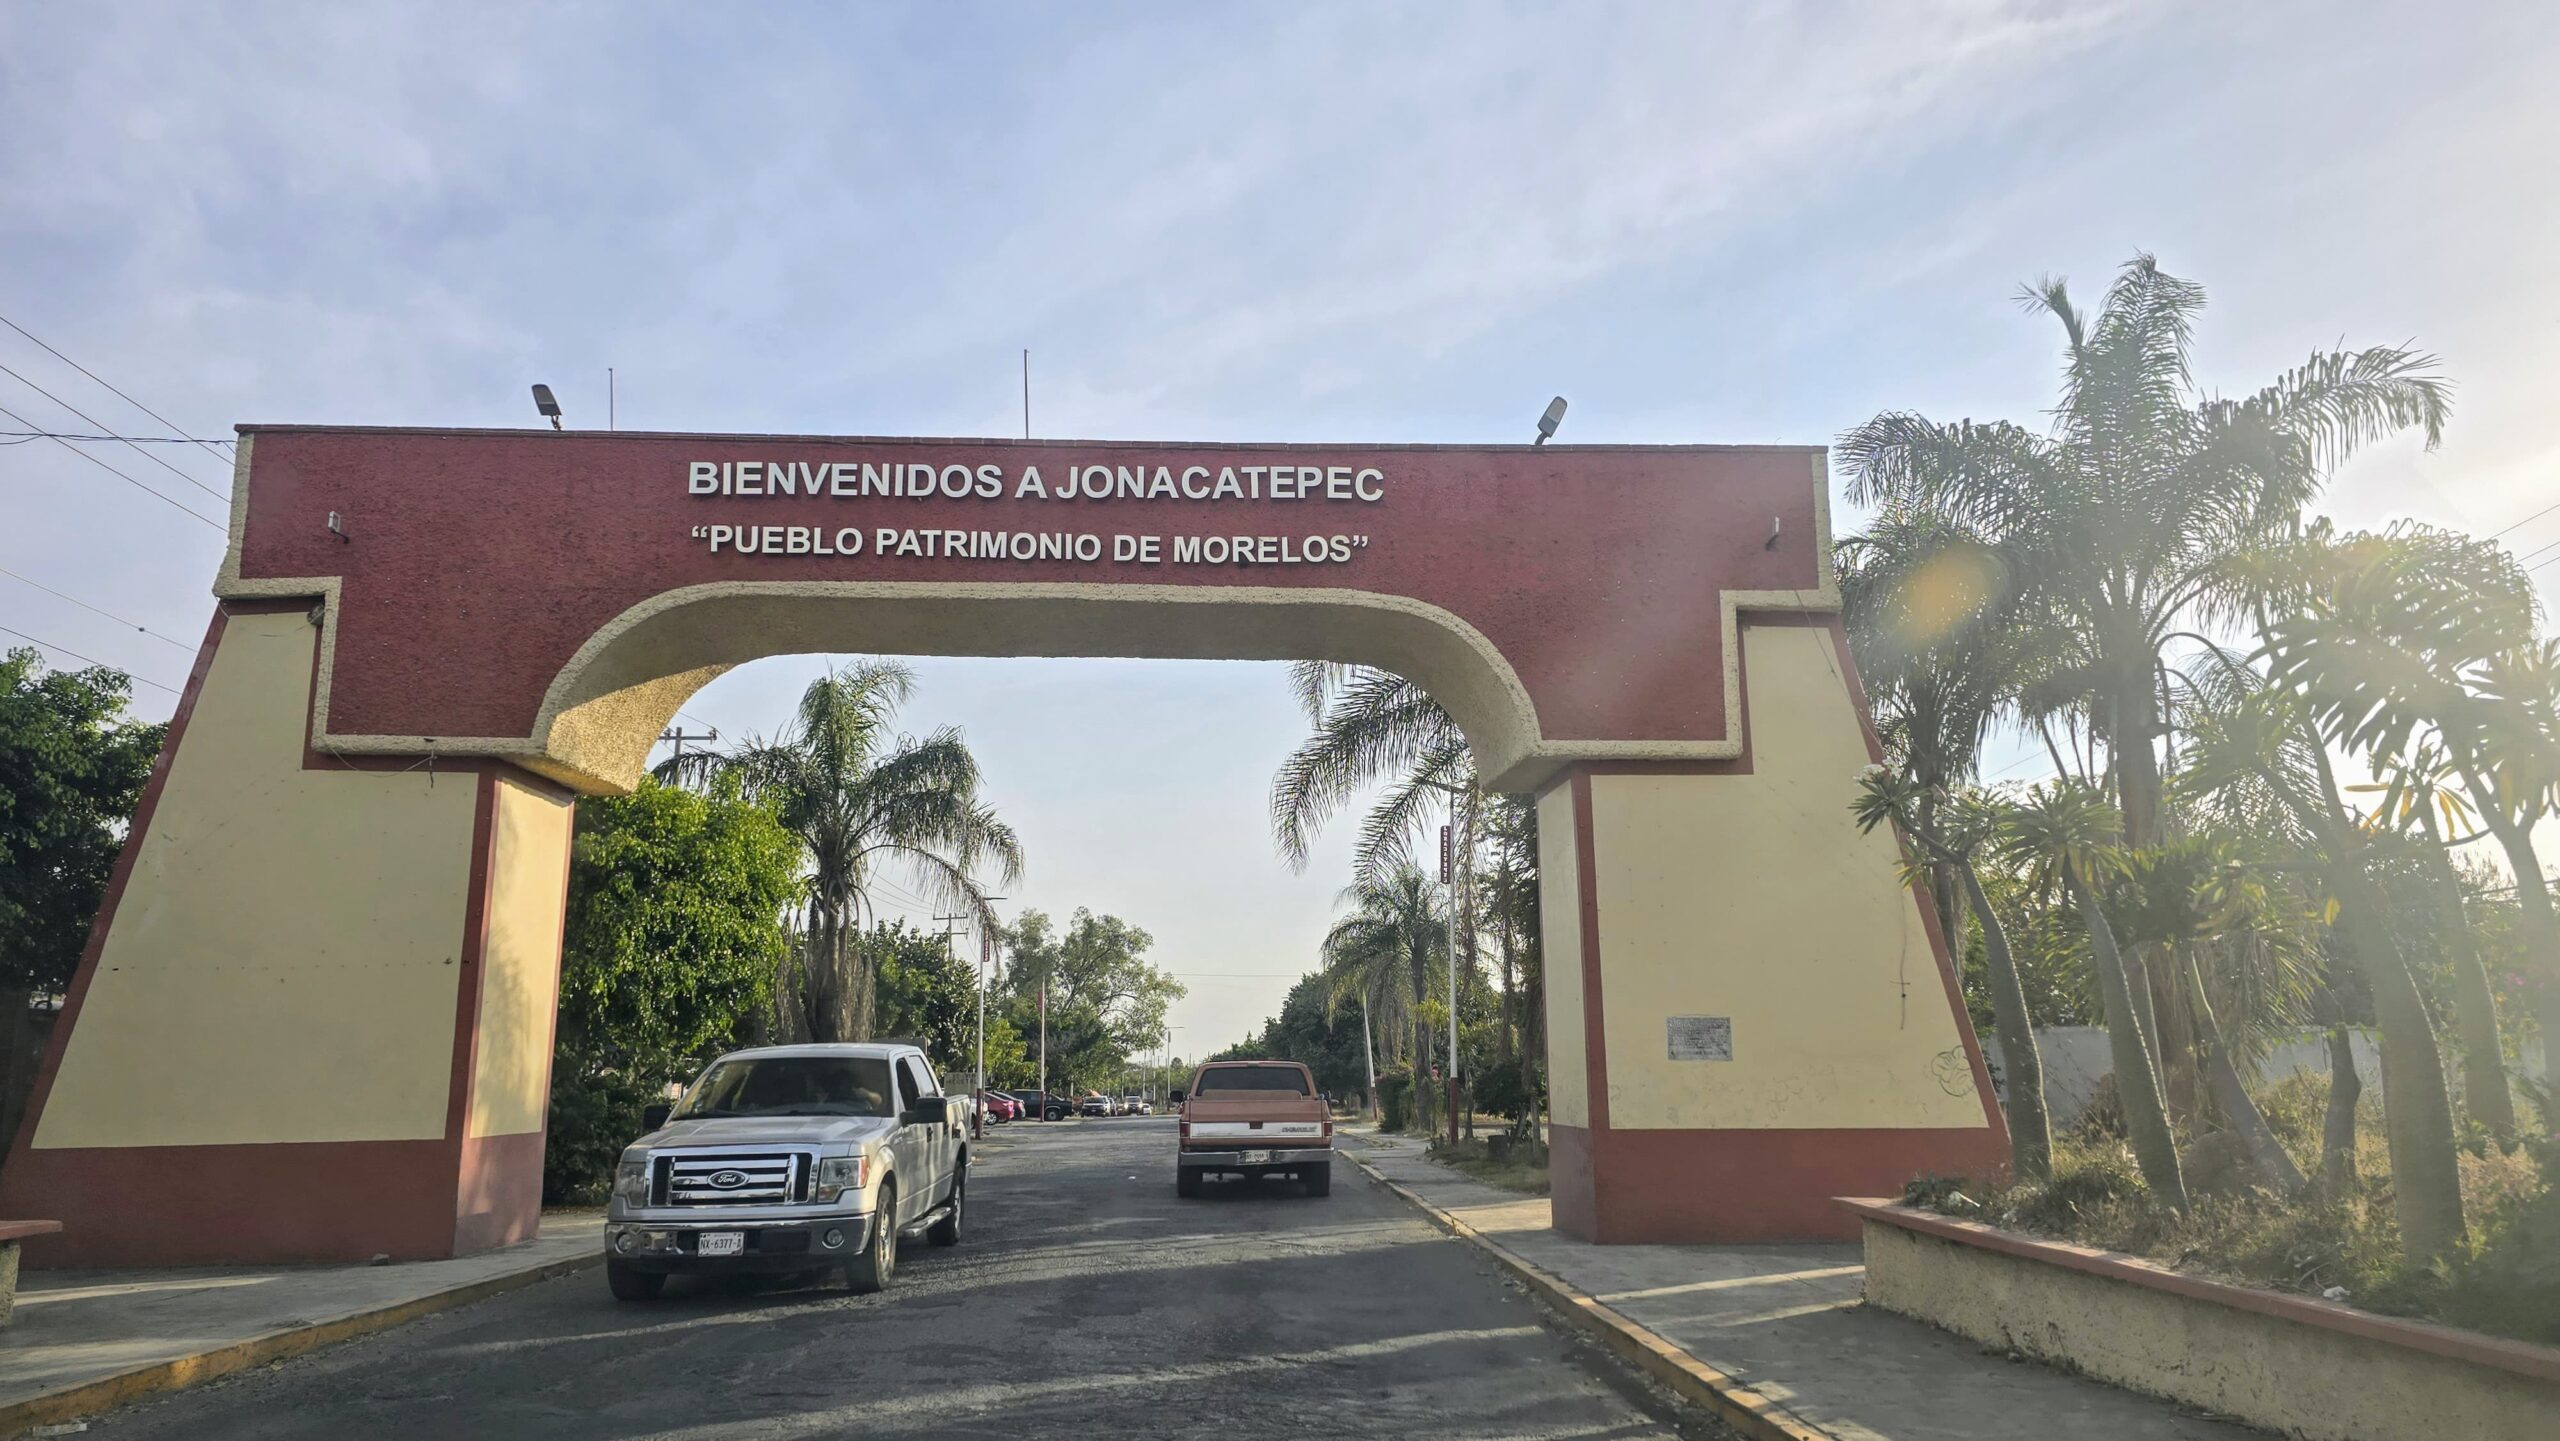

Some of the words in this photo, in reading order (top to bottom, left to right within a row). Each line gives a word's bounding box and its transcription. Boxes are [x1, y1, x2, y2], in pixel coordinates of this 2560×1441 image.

[687, 461, 1003, 498] BIENVENIDOS
[1014, 465, 1049, 499] A
[1055, 465, 1385, 501] JONACATEPEC
[691, 524, 864, 555] “PUEBLO
[876, 528, 1102, 561] PATRIMONIO
[1113, 534, 1161, 563] DE
[1173, 535, 1369, 563] MORELOS”
[717, 1173, 738, 1184] Ford
